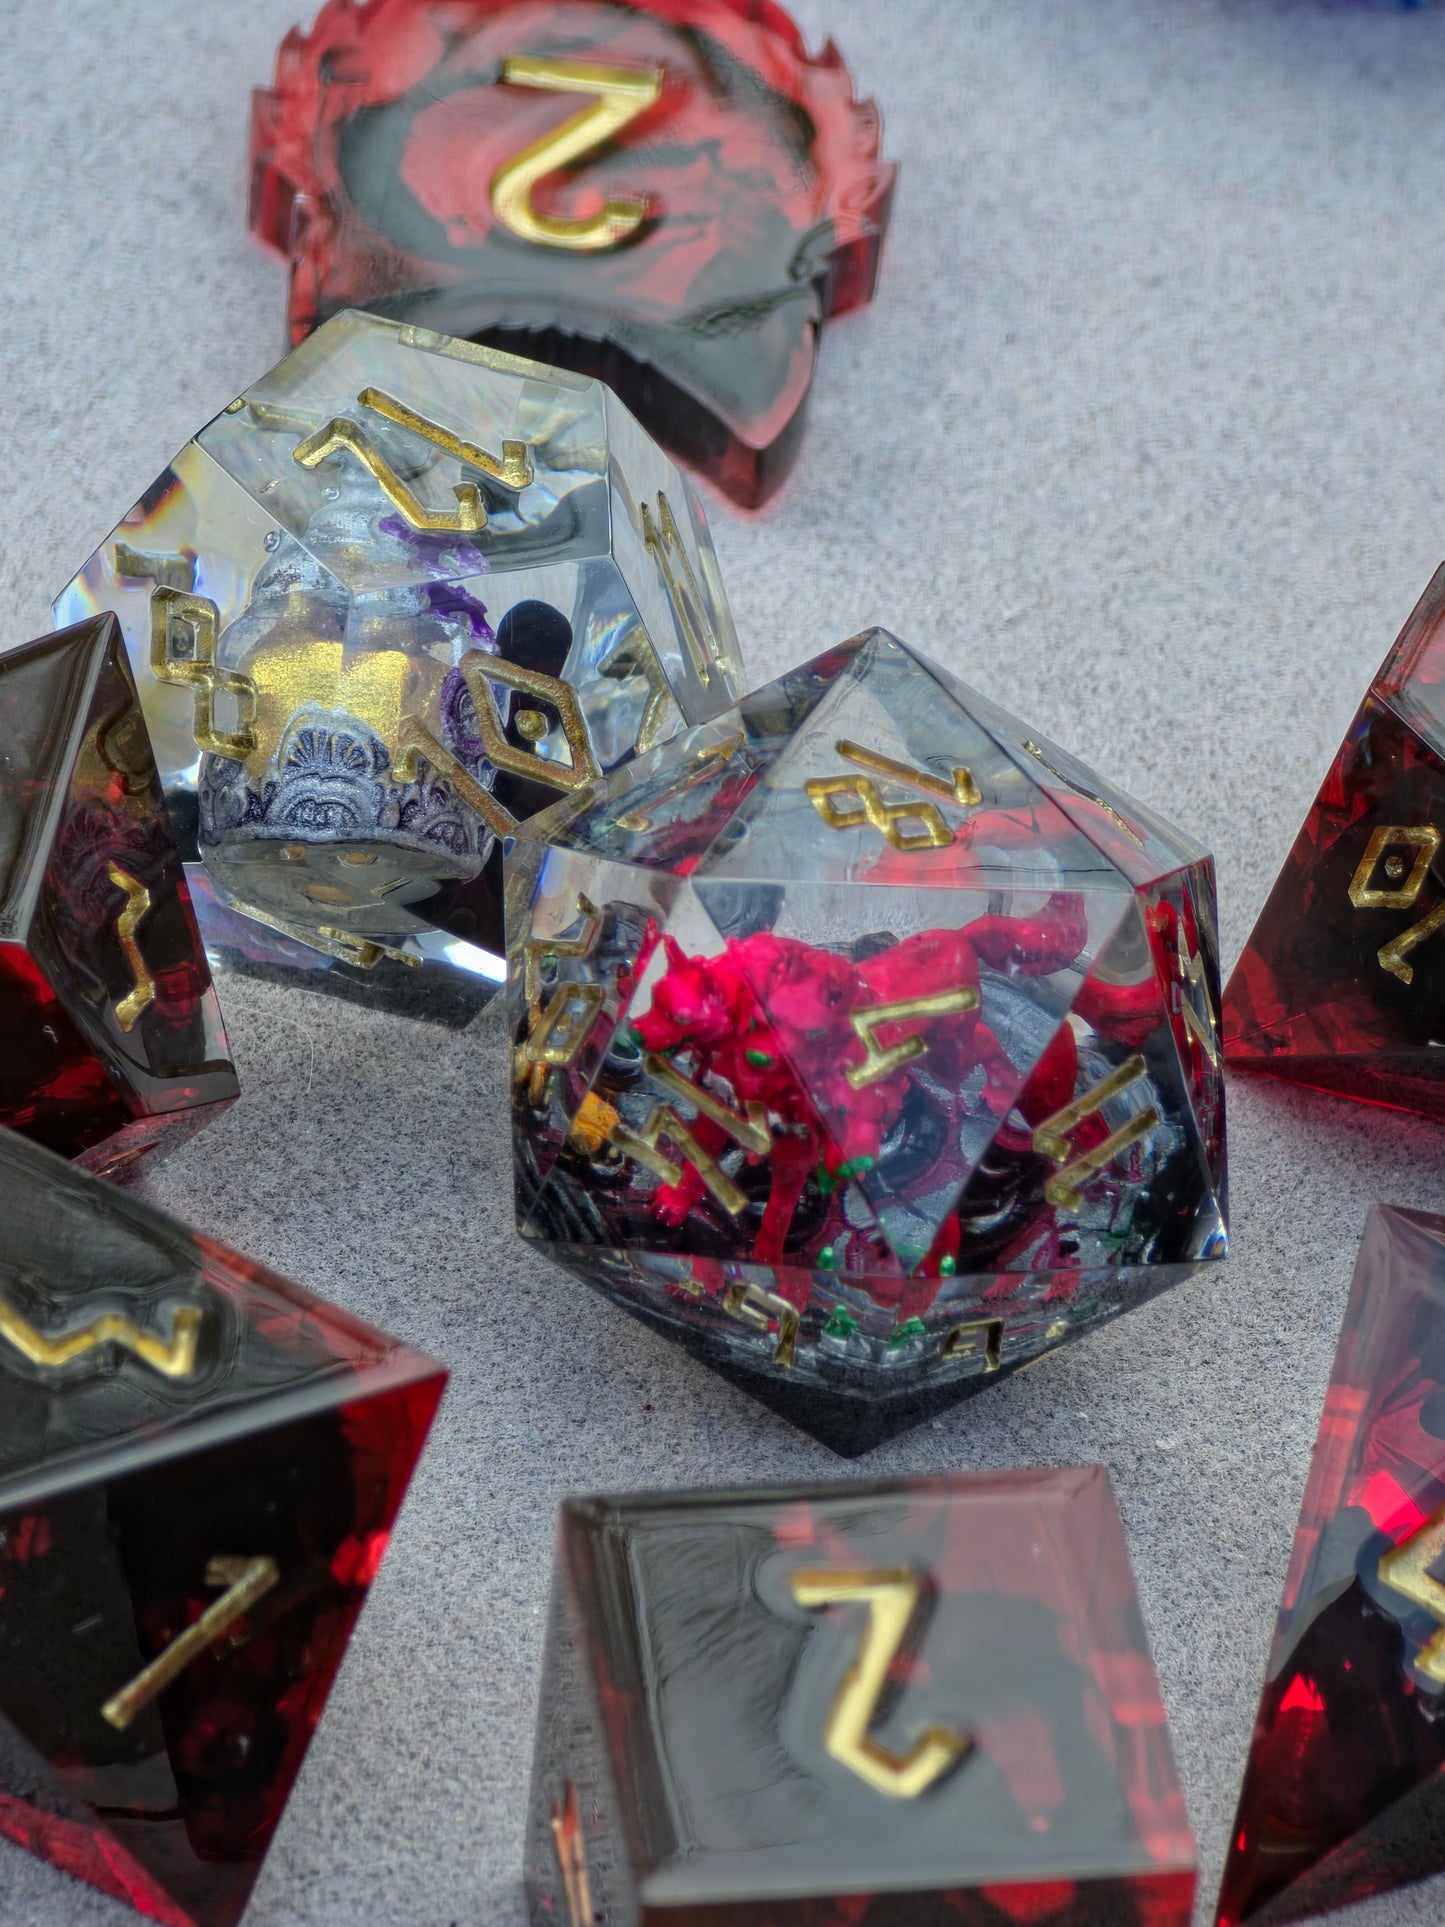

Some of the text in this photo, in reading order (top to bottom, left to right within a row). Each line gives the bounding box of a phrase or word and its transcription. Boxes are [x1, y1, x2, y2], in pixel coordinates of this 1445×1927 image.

[490, 54, 664, 251] 2
[151, 585, 258, 760] 8
[804, 737, 982, 852] 18
[790, 1566, 970, 1799] 2
